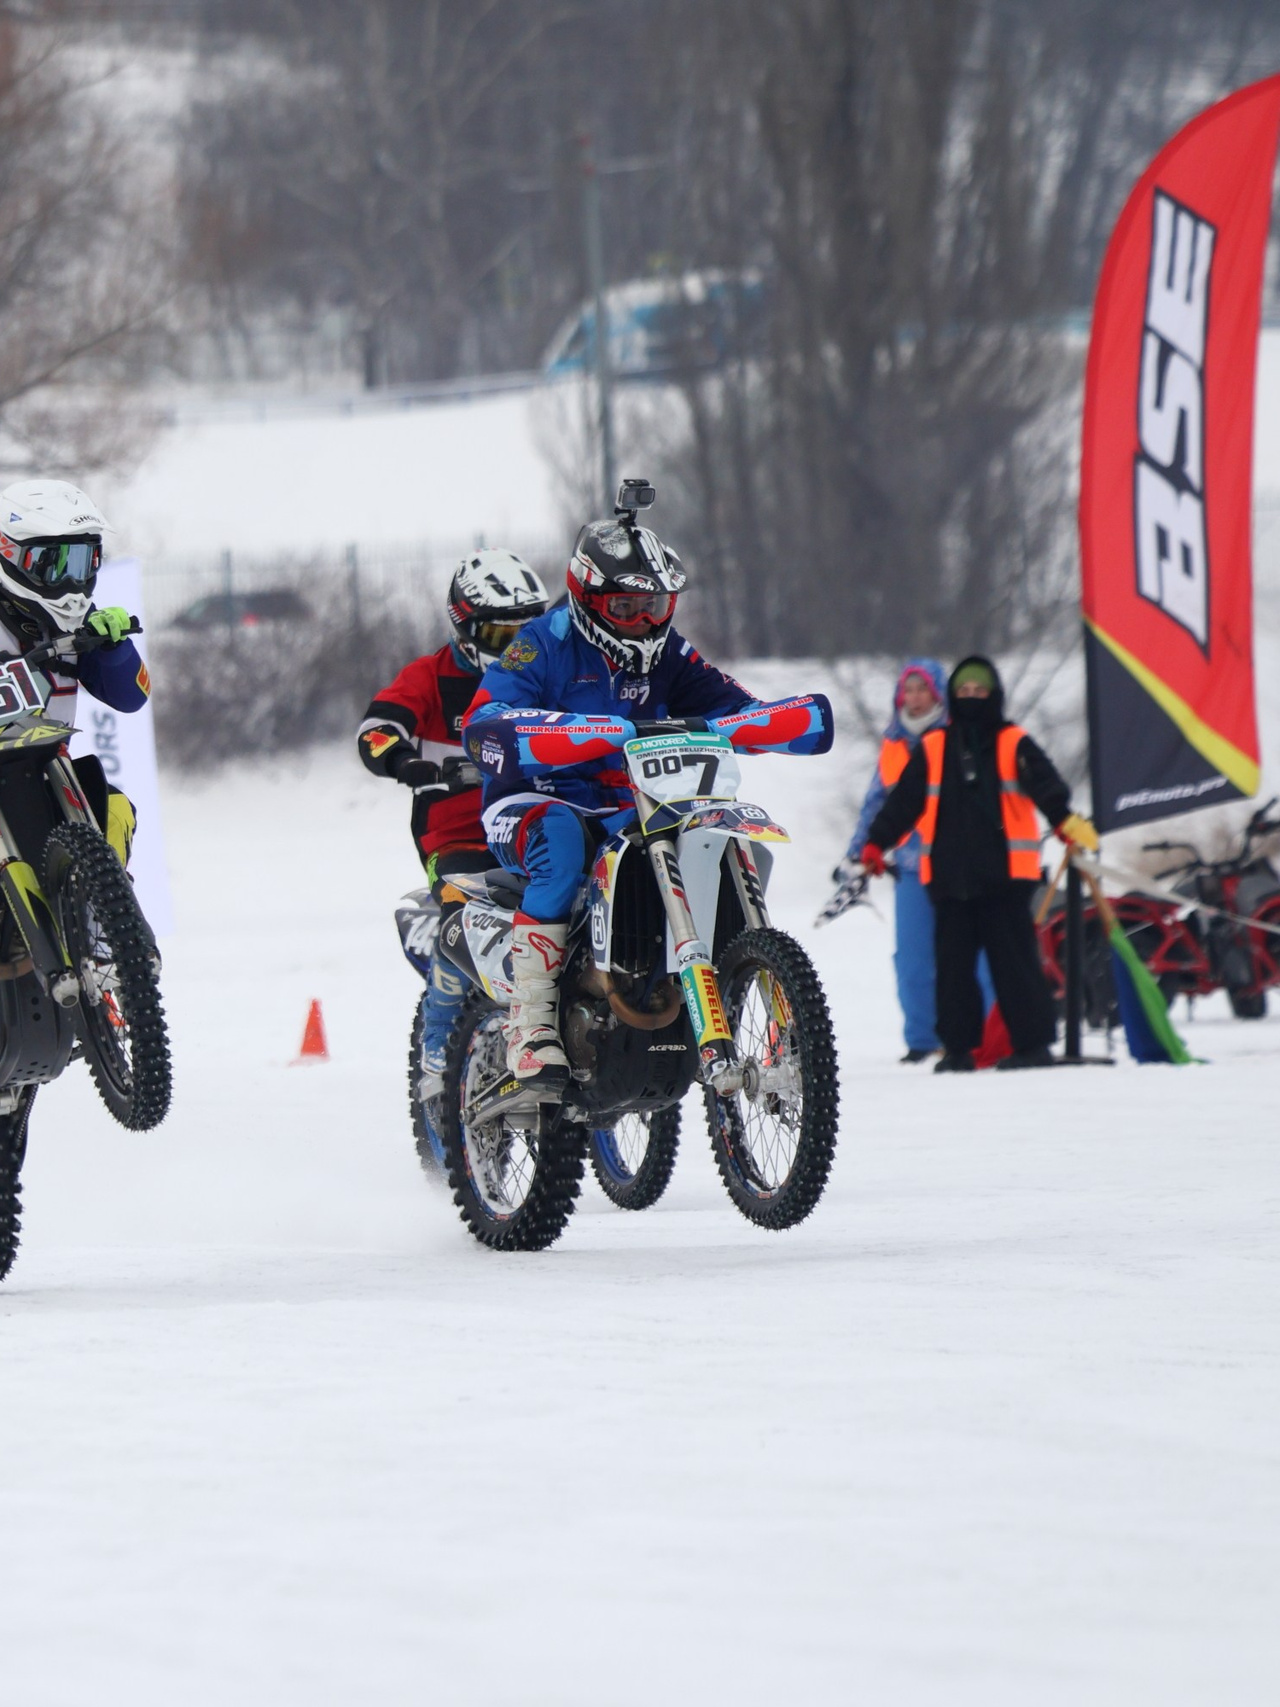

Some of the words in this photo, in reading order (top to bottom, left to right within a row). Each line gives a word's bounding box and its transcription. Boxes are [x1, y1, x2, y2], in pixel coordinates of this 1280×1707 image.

[1133, 186, 1217, 657] BSE
[619, 575, 655, 592] Airoh
[619, 685, 650, 705] 007
[716, 715, 750, 727] SHARK
[750, 704, 787, 719] RACING
[786, 696, 815, 710] TEAM
[515, 725, 552, 735] SHARK
[552, 725, 592, 734] RACING
[593, 725, 624, 735] TEAM
[641, 736, 689, 749] MOTOREX
[482, 749, 504, 774] 007
[636, 748, 678, 760] DMITRIJS
[642, 754, 720, 796] 007
[472, 912, 513, 957] 007
[686, 988, 704, 1036] MOTOREX
[701, 969, 729, 1035] PIRELLI
[647, 1044, 688, 1052] ACERBIS
